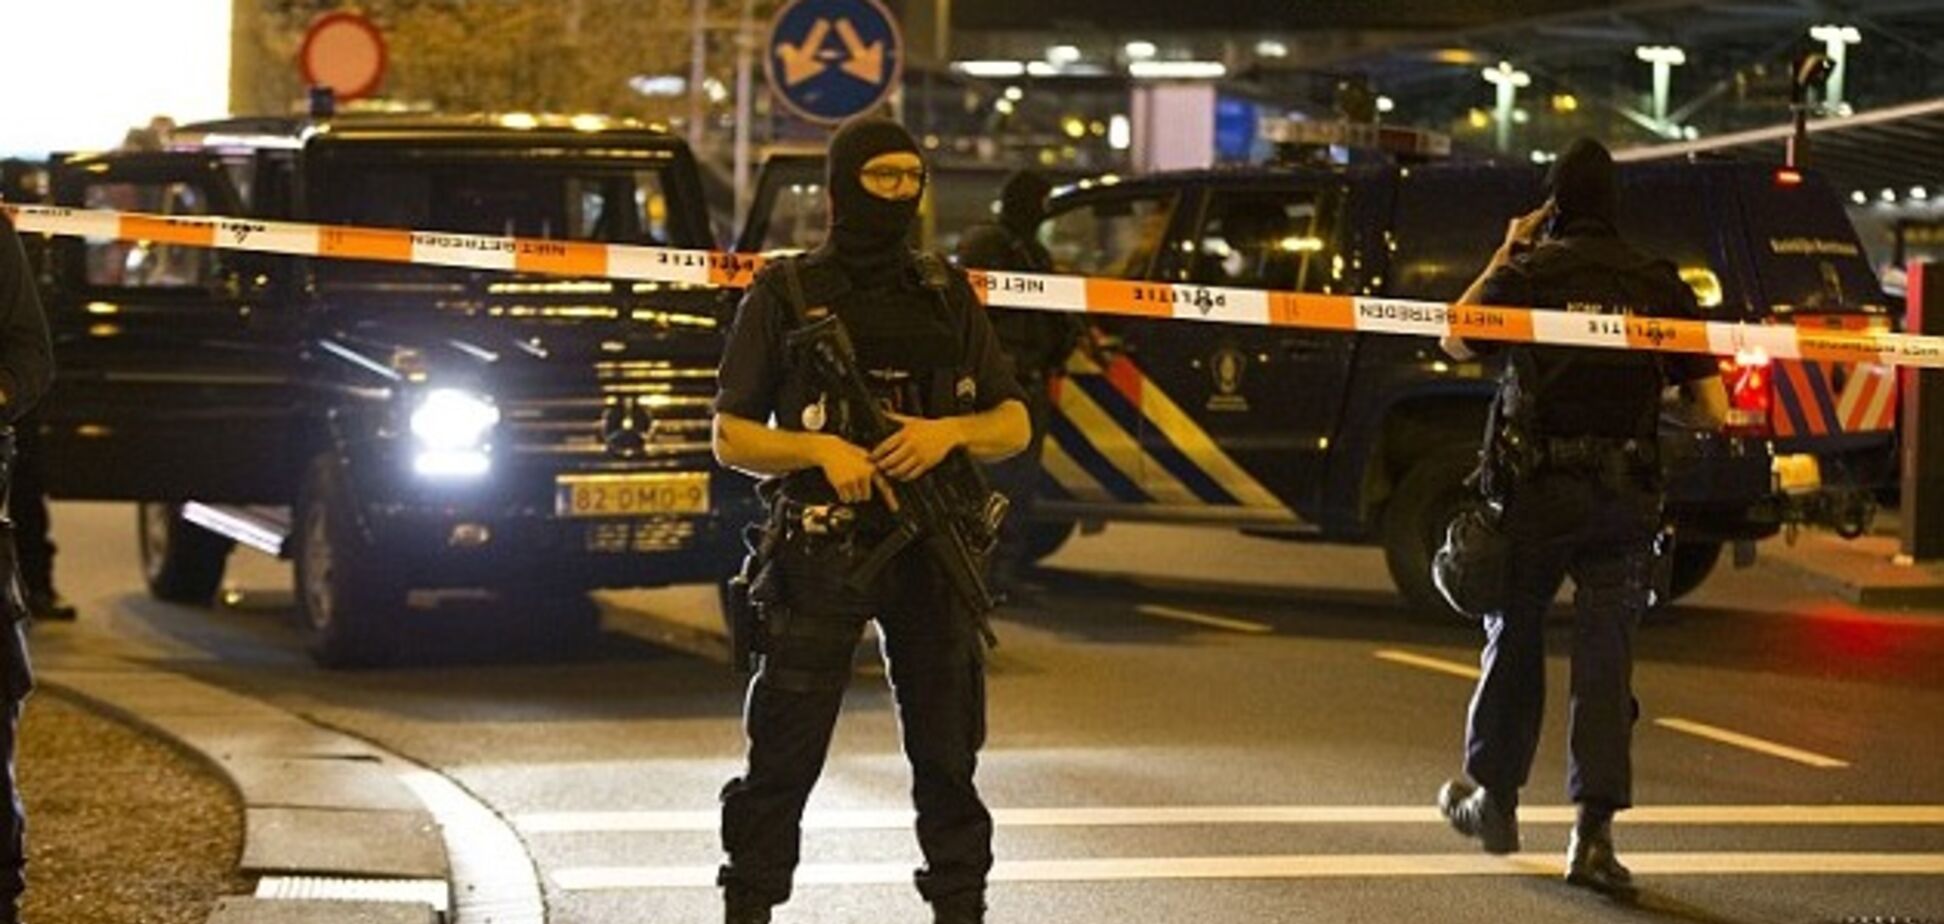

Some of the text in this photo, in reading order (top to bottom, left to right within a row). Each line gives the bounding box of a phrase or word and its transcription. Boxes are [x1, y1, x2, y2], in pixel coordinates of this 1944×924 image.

[1003, 277, 1044, 293] NIET
[1359, 303, 1504, 327] NIET BETREDEN
